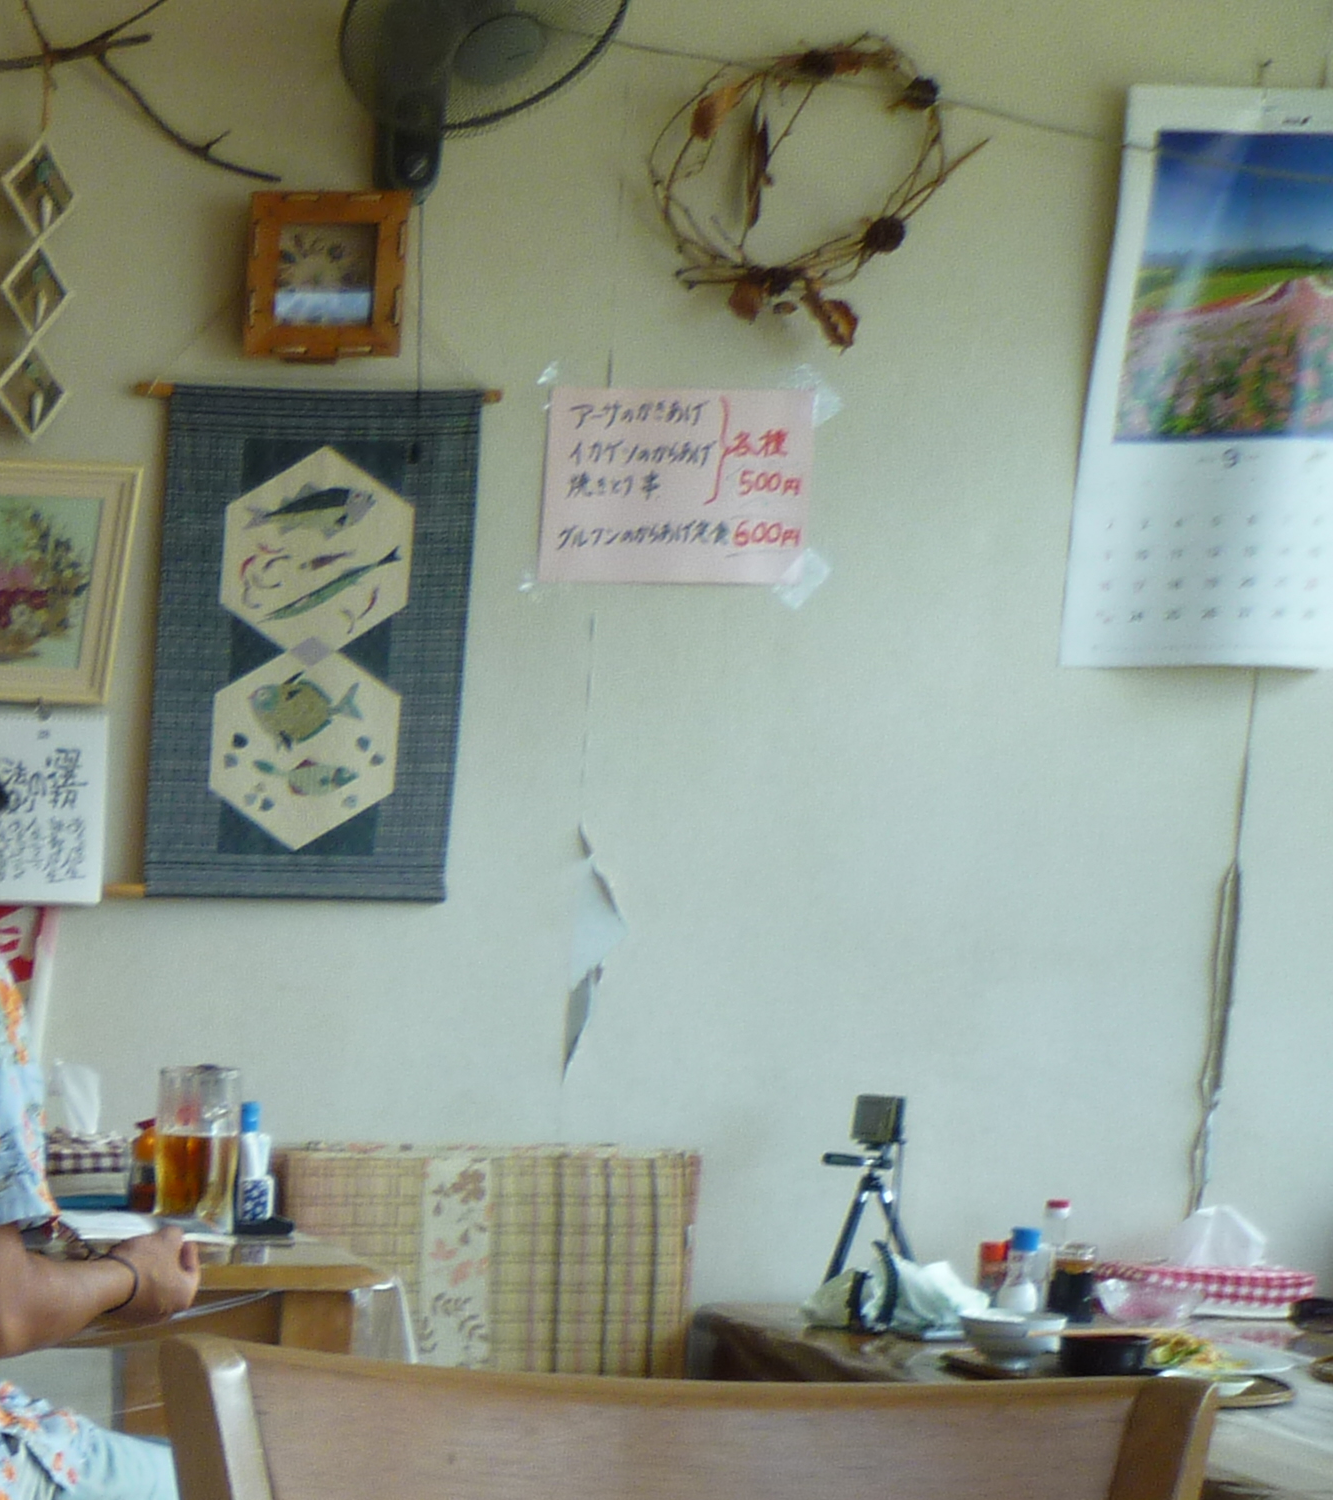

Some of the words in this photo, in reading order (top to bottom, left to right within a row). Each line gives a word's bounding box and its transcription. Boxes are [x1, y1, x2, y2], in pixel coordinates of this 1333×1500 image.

[1222, 448, 1239, 469] 9
[739, 470, 802, 496] 500円
[734, 520, 802, 547] 600円
